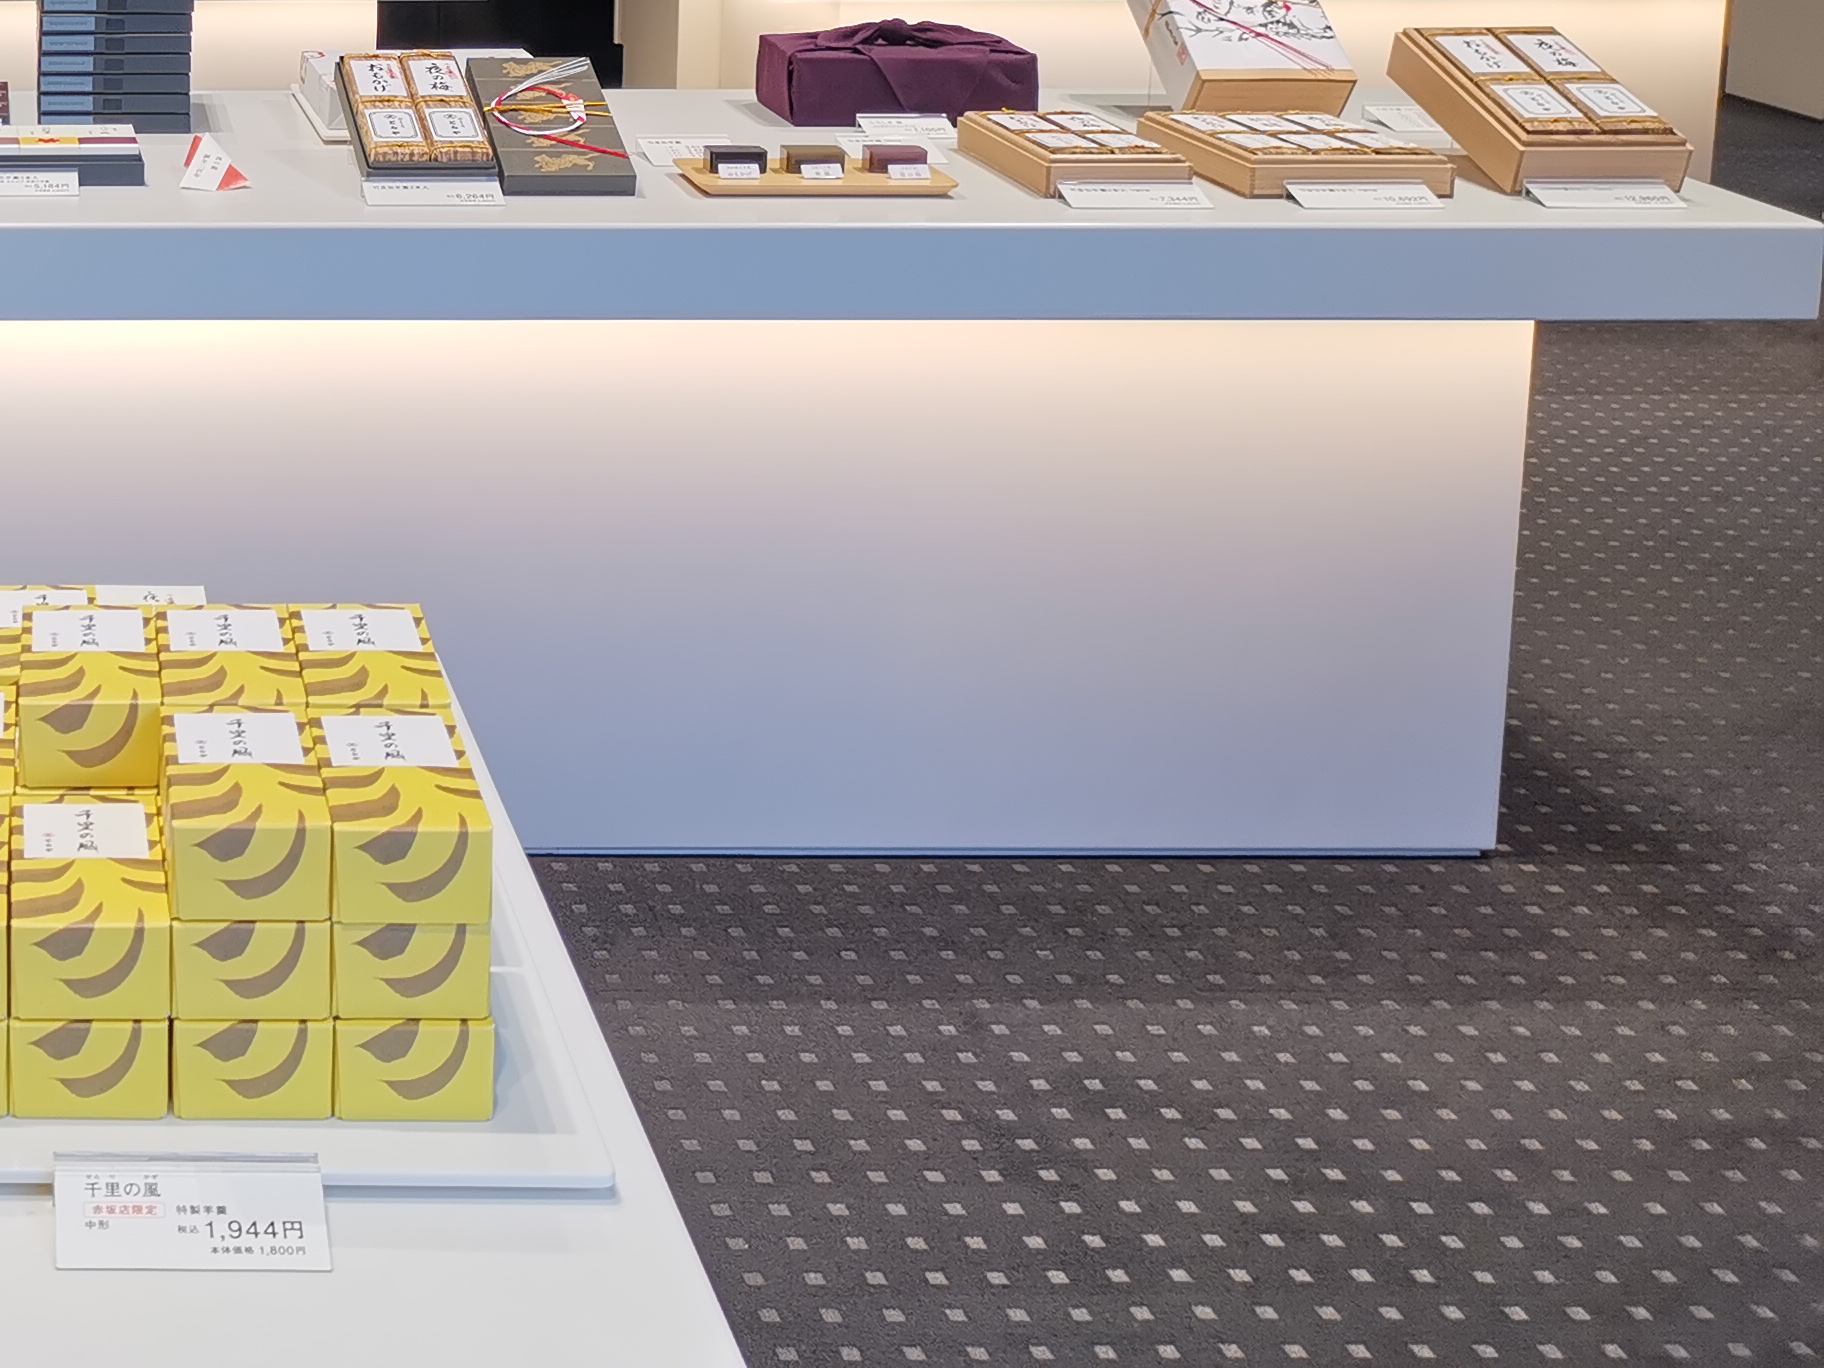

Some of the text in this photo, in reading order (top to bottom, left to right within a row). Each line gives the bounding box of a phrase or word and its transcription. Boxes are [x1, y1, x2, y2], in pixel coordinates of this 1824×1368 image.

[368, 63, 389, 93] おもかげ
[425, 62, 453, 92] 夜の梅
[226, 718, 253, 759] 千里の風
[375, 720, 407, 761] 千里の風
[75, 809, 100, 854] 千里の風
[83, 1181, 161, 1198] 千里の風
[91, 1204, 158, 1216] 赤坂店限定
[175, 1204, 228, 1216] 特製羊羹
[84, 1219, 110, 1231] 中形
[177, 1220, 305, 1243] 税込 1,944円
[210, 1245, 307, 1257] 本体価格 1,800円
